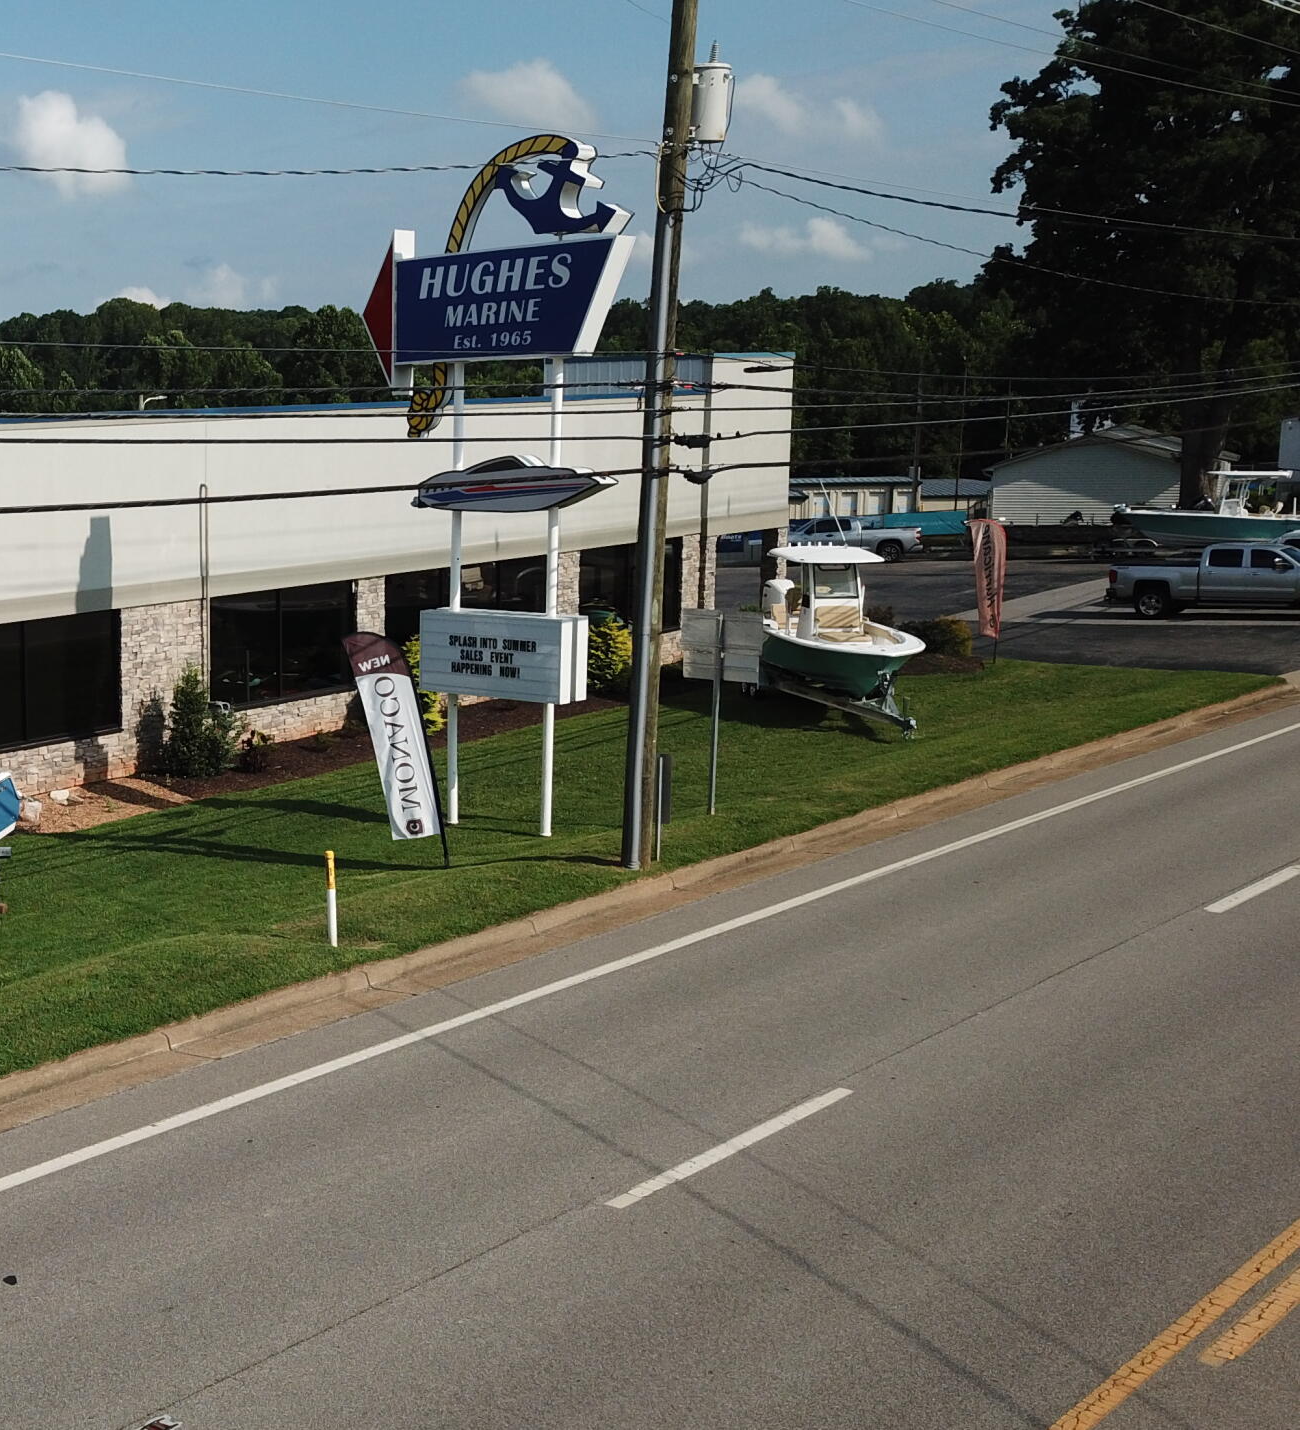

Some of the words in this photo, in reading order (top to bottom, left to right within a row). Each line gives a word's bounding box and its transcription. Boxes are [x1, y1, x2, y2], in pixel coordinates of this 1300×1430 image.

[419, 253, 572, 300] HUGHES
[444, 298, 542, 328] MARINE
[453, 334, 482, 350] Est.
[490, 330, 532, 348] 1965
[449, 635, 477, 648] SPLASH
[480, 637, 497, 650] INTO
[502, 639, 537, 652] SUMMER
[460, 649, 483, 662] SALES
[490, 652, 514, 664] EVENT
[451, 662, 493, 676] HAPPENING
[499, 666, 521, 678] NOW!
